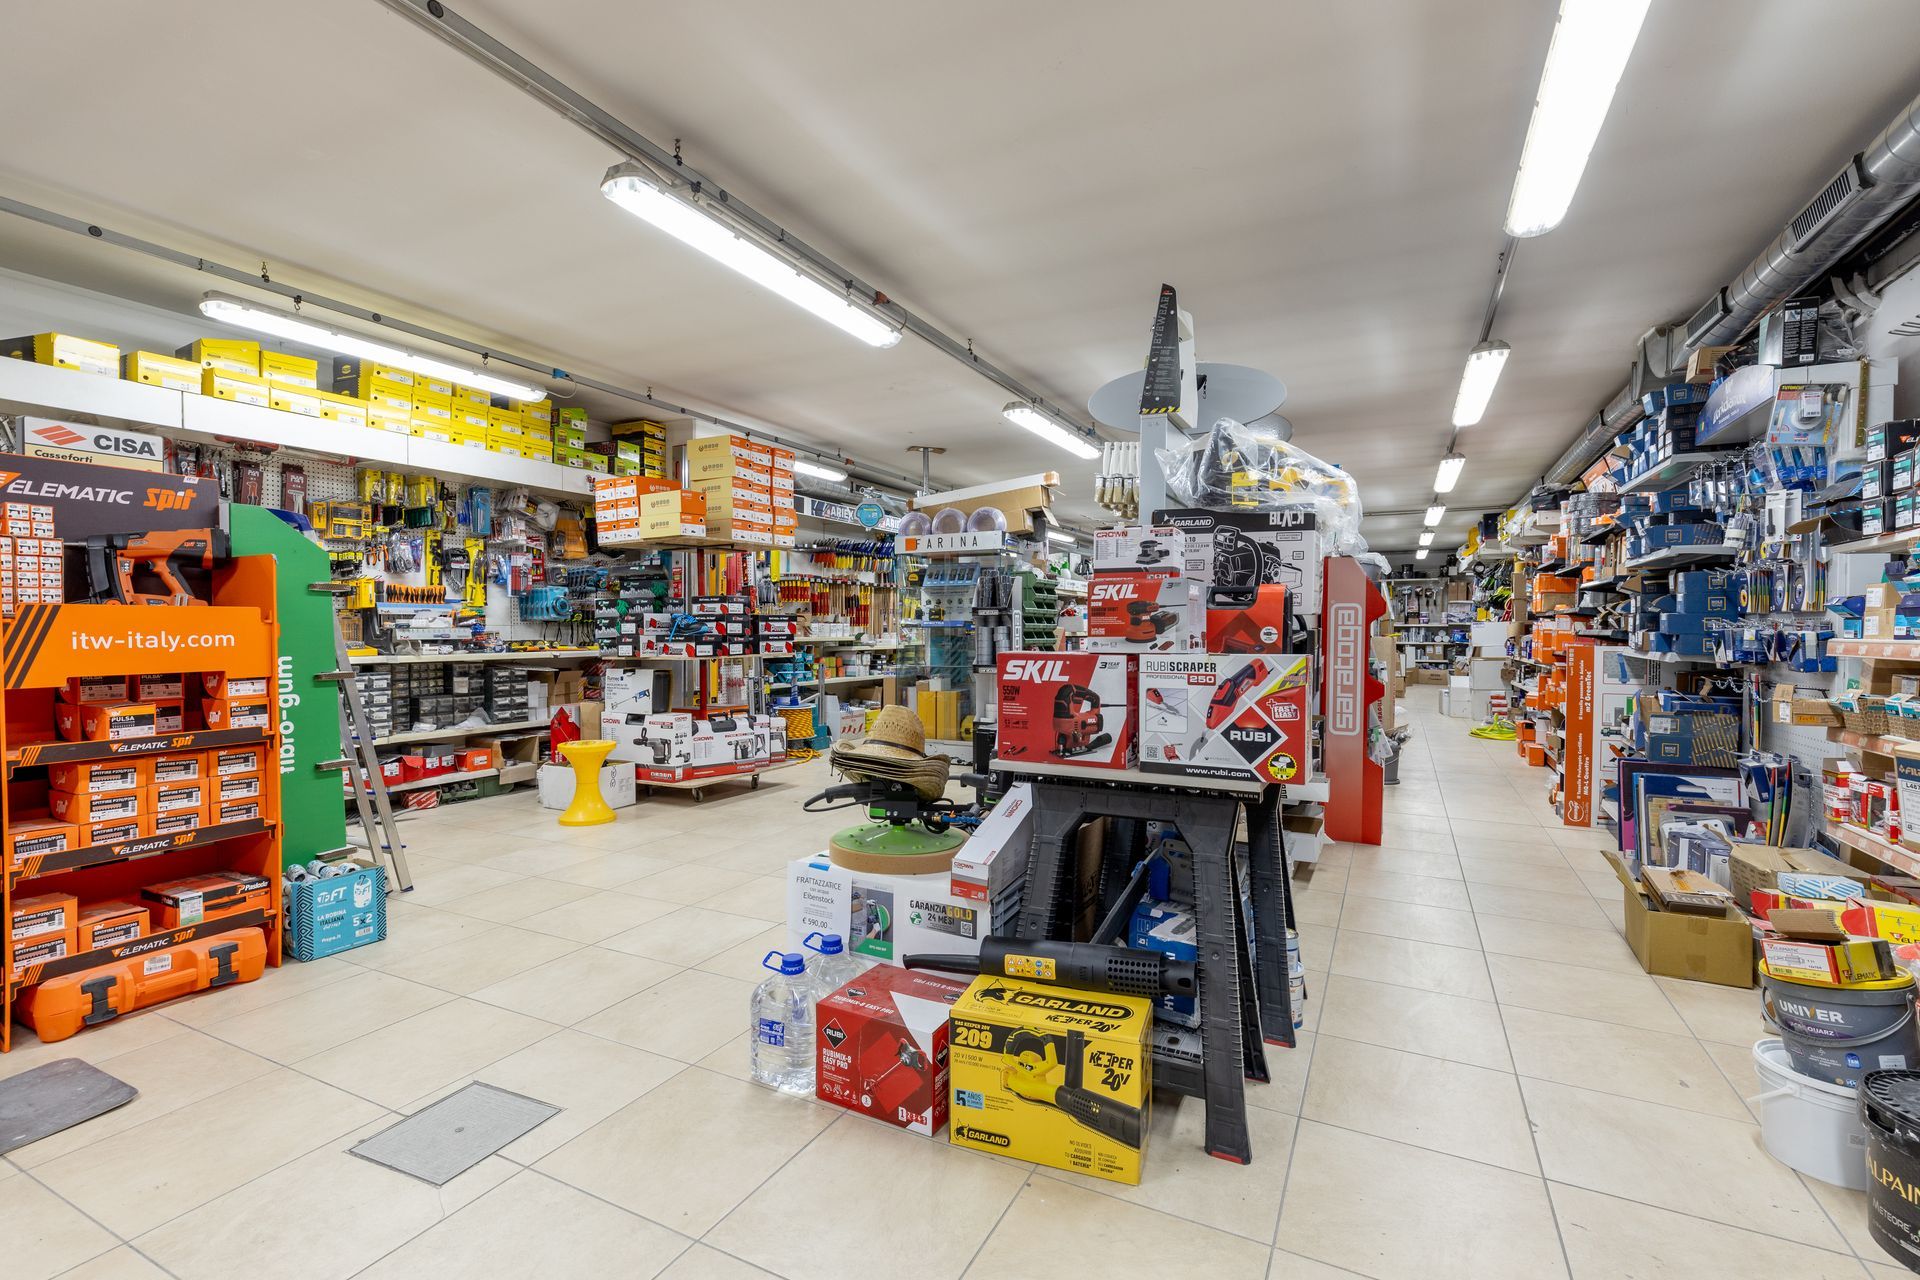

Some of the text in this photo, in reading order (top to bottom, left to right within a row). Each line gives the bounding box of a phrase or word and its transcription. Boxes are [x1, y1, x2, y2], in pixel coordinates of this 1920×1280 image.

[93, 434, 157, 457] CISA
[34, 449, 94, 464] Casseforti
[6, 479, 198, 512] ELEMATIC spit
[1091, 584, 1139, 601] SKIL
[71, 630, 236, 652] itw-italy.com
[1002, 659, 1070, 684] SKIL
[1146, 661, 1217, 673] RUBISCRAPER
[1335, 609, 1363, 730] saratoga
[1189, 675, 1215, 683] 250
[1002, 685, 1021, 695] 550W
[111, 715, 135, 723] PULSA
[118, 734, 195, 753] ELEMATIC spit
[1230, 730, 1272, 743] RUBI
[1186, 767, 1251, 778] www.rubi.com
[118, 831, 197, 855] ELEMATIC spit
[953, 860, 974, 870] CROWN
[796, 875, 842, 892] FRATTAZZATICE
[803, 891, 835, 905] Eibenstock
[909, 900, 947, 915] GARANZIA
[808, 917, 828, 929] 590,00
[927, 913, 955, 926] 24 MESI
[119, 927, 197, 957] ELEMATIC spit
[864, 1001, 880, 1012] EASY
[880, 1007, 895, 1015] PRO
[1016, 994, 1127, 1018] GARLAND
[1778, 999, 1845, 1024] UNIVER
[963, 1021, 981, 1029] KEEPER
[826, 1028, 844, 1040] RUBI
[955, 1026, 992, 1049] 209
[822, 1048, 852, 1064] RUBIMIX-8
[823, 1055, 849, 1070] EASY PRO
[956, 1090, 967, 1107] 5
[968, 1130, 1009, 1147] GARLAND
[1070, 1153, 1092, 1162] CARGADOR
